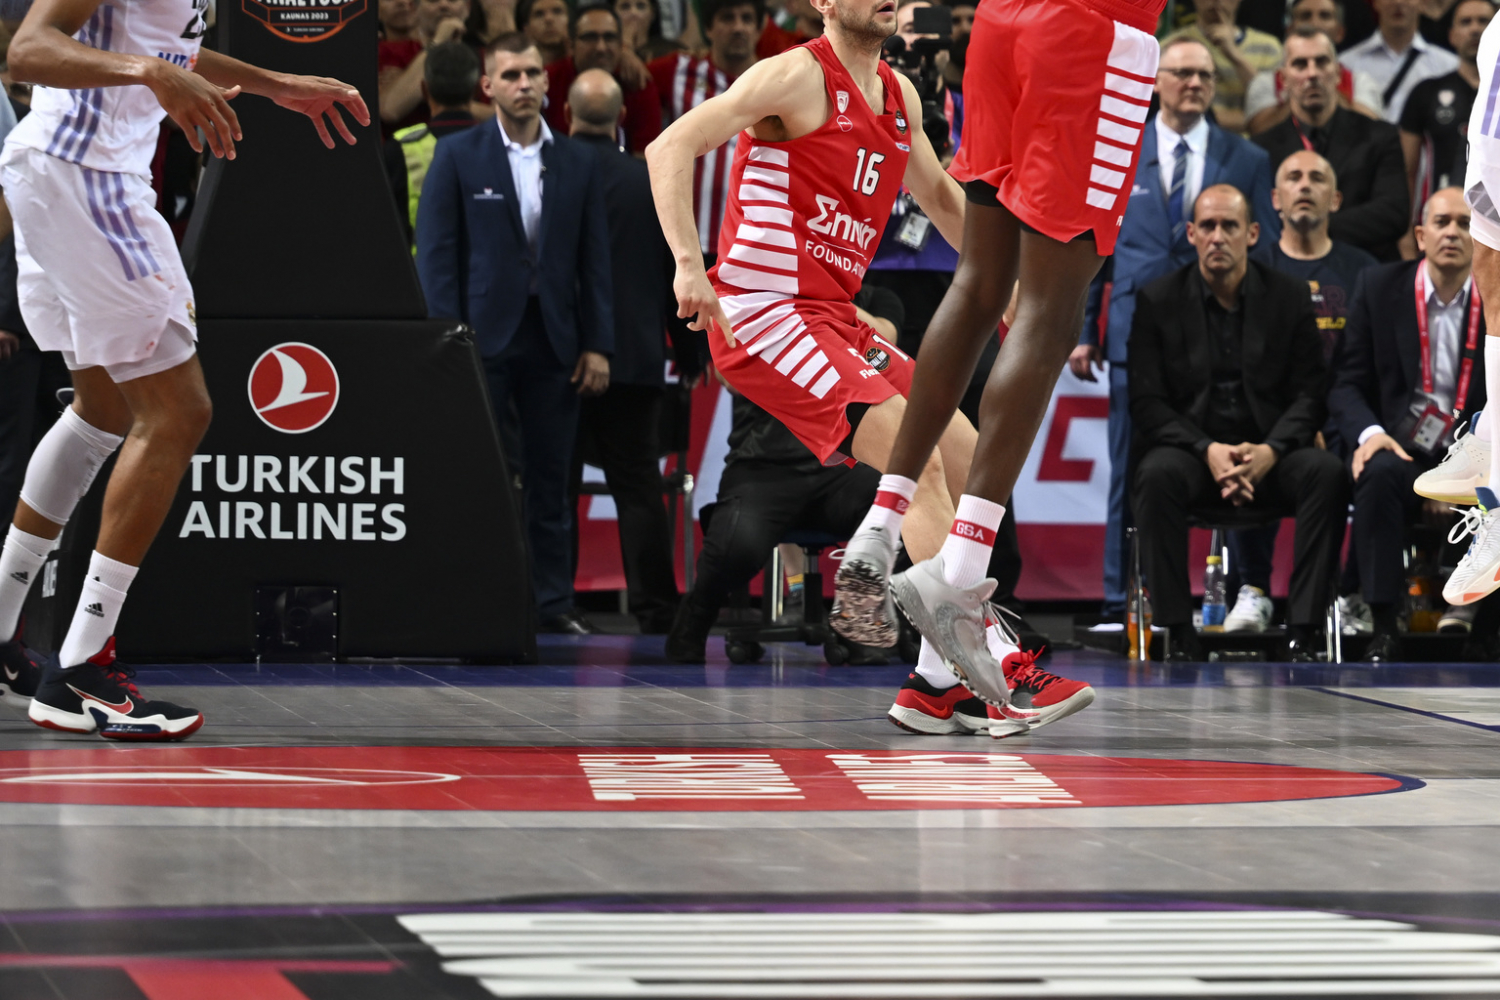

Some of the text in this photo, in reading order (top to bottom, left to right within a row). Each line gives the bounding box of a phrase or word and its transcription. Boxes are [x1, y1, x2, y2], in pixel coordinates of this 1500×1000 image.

[280, 12, 328, 20] KAUNAS 2023
[853, 147, 885, 196] 16
[190, 454, 405, 495] TURKISH
[178, 501, 407, 541] AIRLINES
[956, 521, 984, 541] GSA
